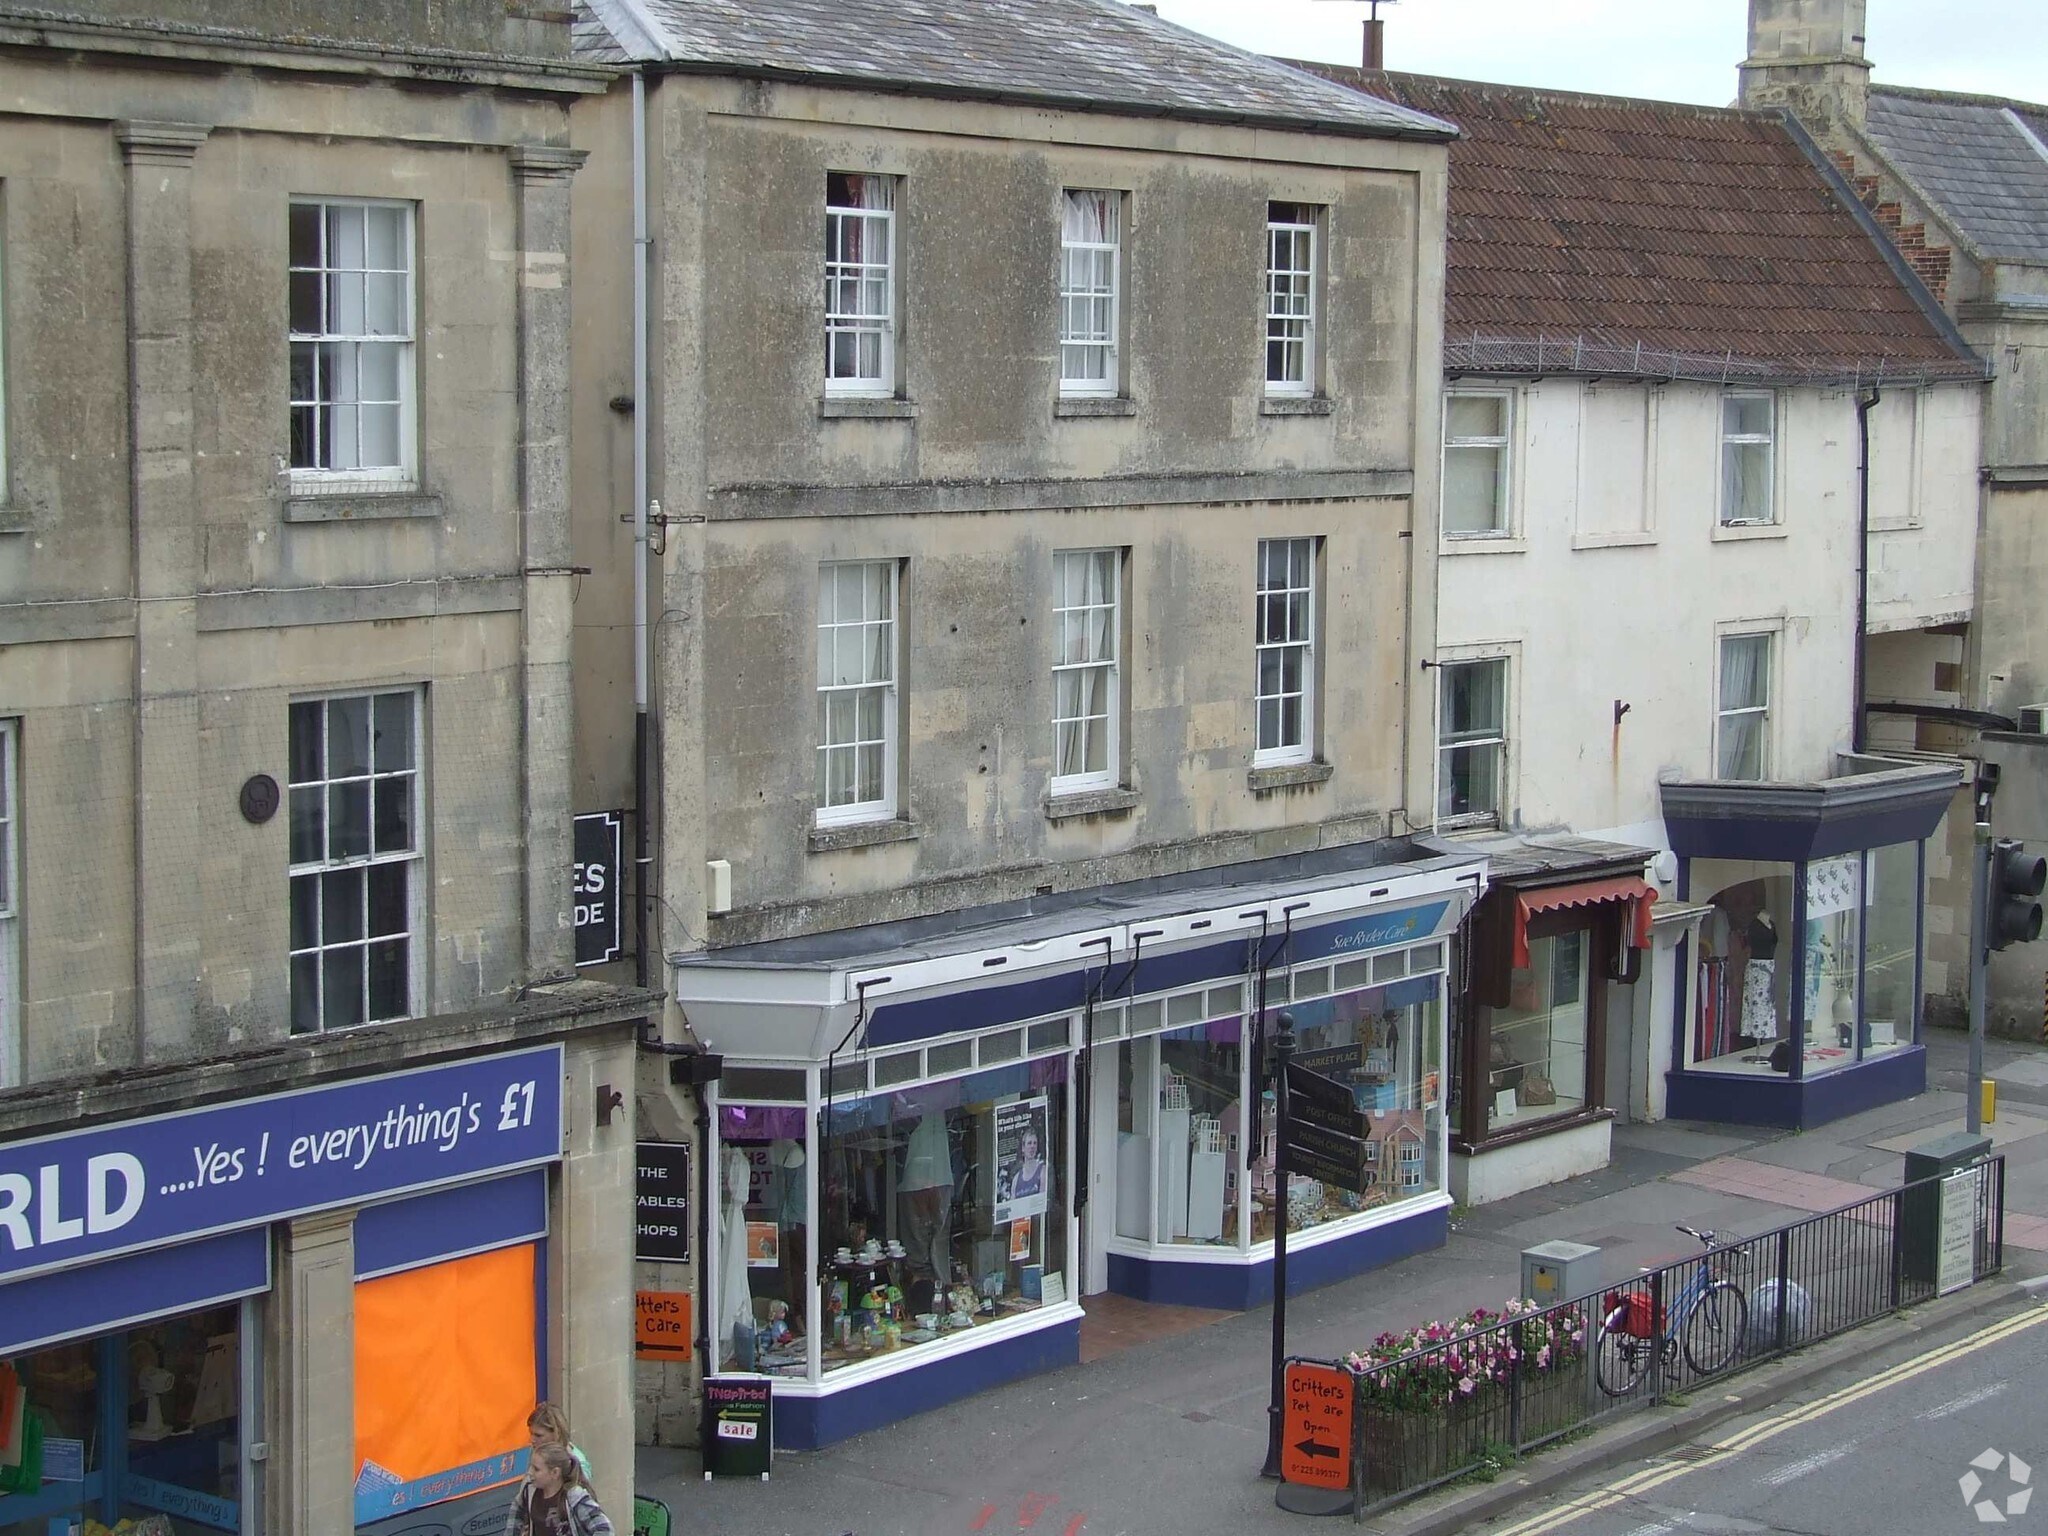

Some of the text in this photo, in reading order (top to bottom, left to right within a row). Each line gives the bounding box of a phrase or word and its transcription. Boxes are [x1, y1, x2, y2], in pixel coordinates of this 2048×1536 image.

[1330, 925, 1410, 950] Sue Ryder Care
[1304, 1052, 1359, 1068] MARKET PLACE
[1305, 1106, 1353, 1126] POST OFFICE
[288, 1092, 482, 1170] everything's
[497, 1080, 536, 1131] £1
[638, 1167, 668, 1179] THE
[636, 1195, 686, 1208] ABLES
[636, 1225, 678, 1237] HOPS
[645, 1317, 682, 1333] Care
[1292, 1378, 1344, 1399] Critters
[1292, 1399, 1310, 1413] Pet
[724, 1424, 753, 1436] sale
[1303, 1420, 1330, 1434] Open
